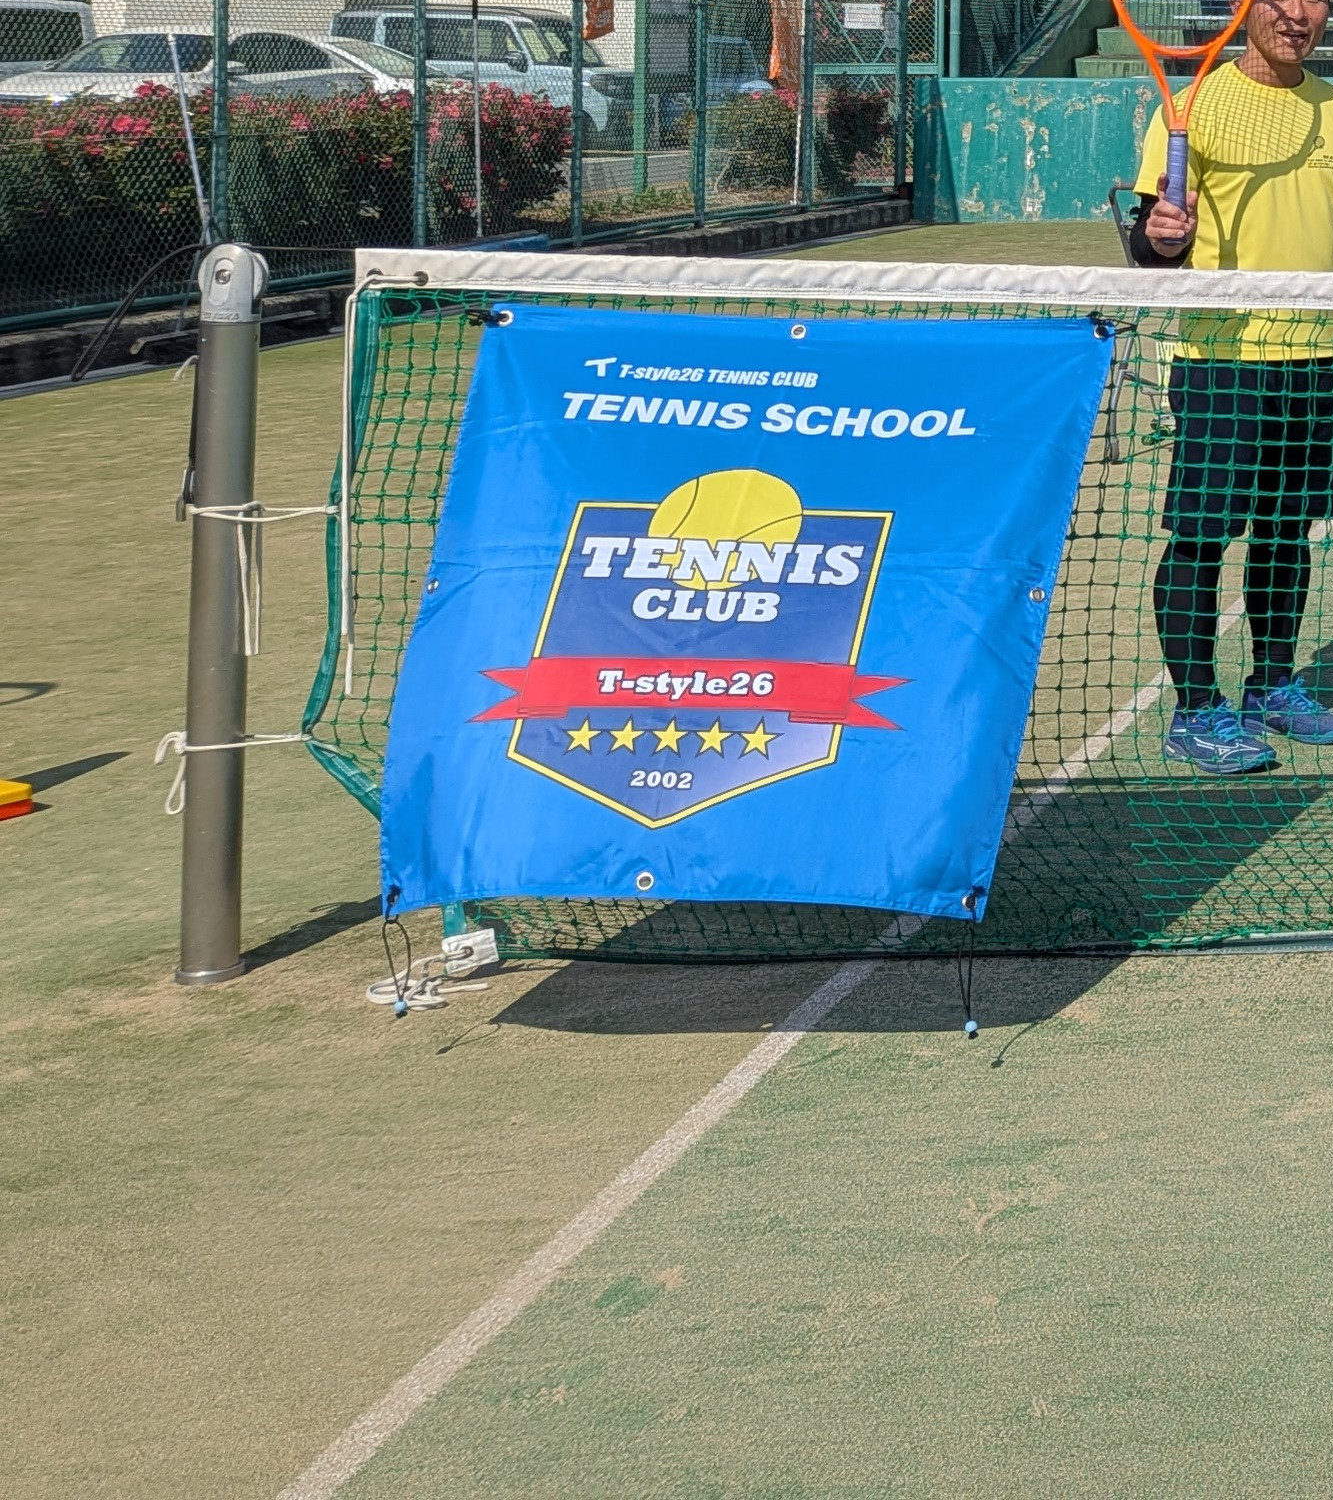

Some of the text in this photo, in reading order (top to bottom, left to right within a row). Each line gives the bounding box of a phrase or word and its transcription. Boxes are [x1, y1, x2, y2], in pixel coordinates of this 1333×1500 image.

[619, 363, 703, 382] T-style26
[707, 368, 769, 387] TENNIS
[771, 371, 819, 388] CLUB
[562, 392, 977, 438] TENNIS SCHOOL
[581, 536, 865, 586] TENNIS
[631, 588, 781, 623] CLUB
[597, 669, 775, 701] T-style26
[628, 769, 694, 791] 2002
